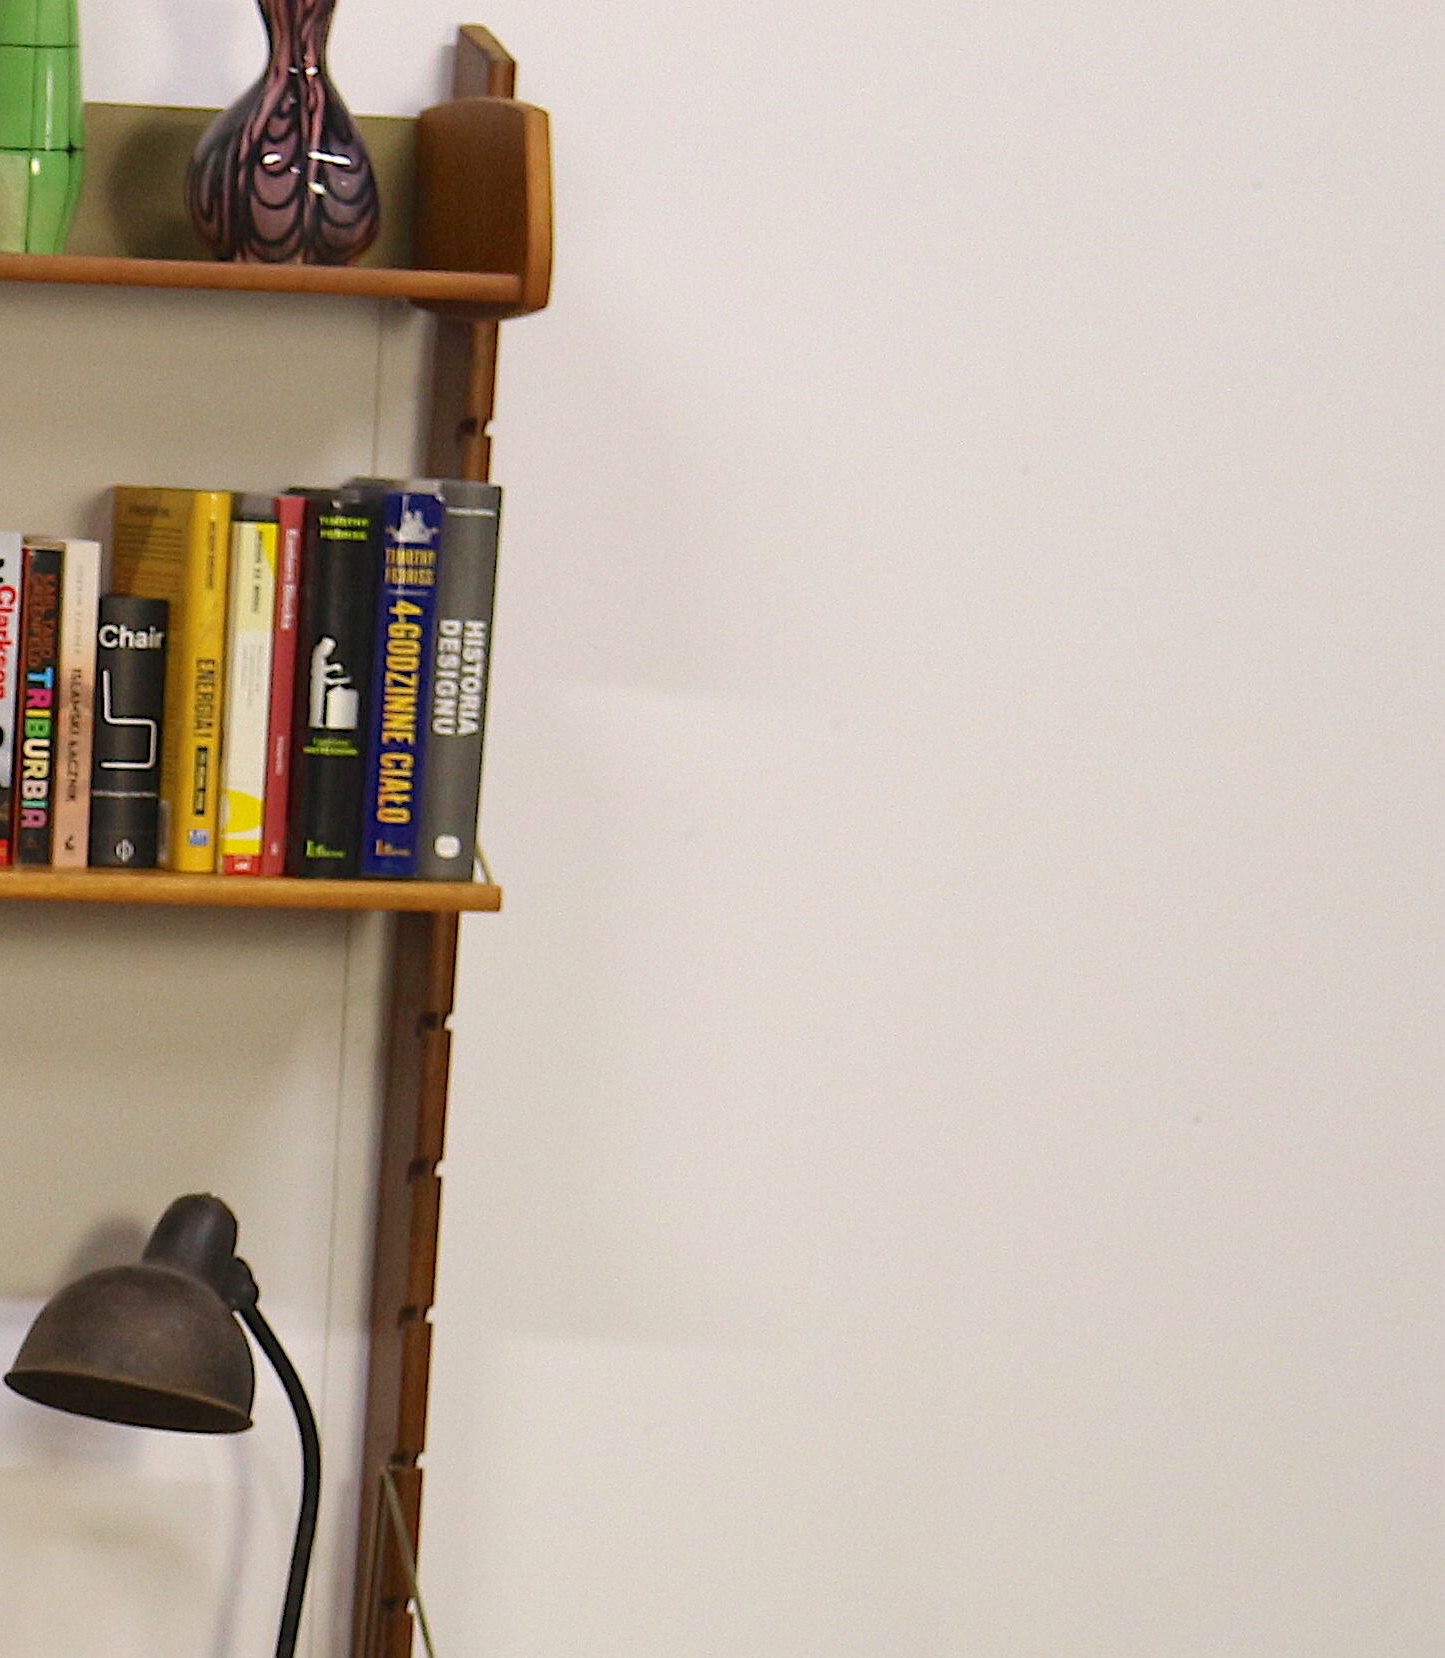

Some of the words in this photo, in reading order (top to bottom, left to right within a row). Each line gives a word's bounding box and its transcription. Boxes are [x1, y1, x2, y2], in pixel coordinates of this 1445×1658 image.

[98, 624, 165, 651] Chair
[381, 600, 424, 745] 4-GODZINNE
[431, 619, 461, 736] DESIGNU
[457, 620, 488, 737] HISTORIA
[20, 667, 55, 829] TRIBURBIA
[194, 658, 216, 739] ENERGIA!
[376, 752, 414, 824] CIAŁO
